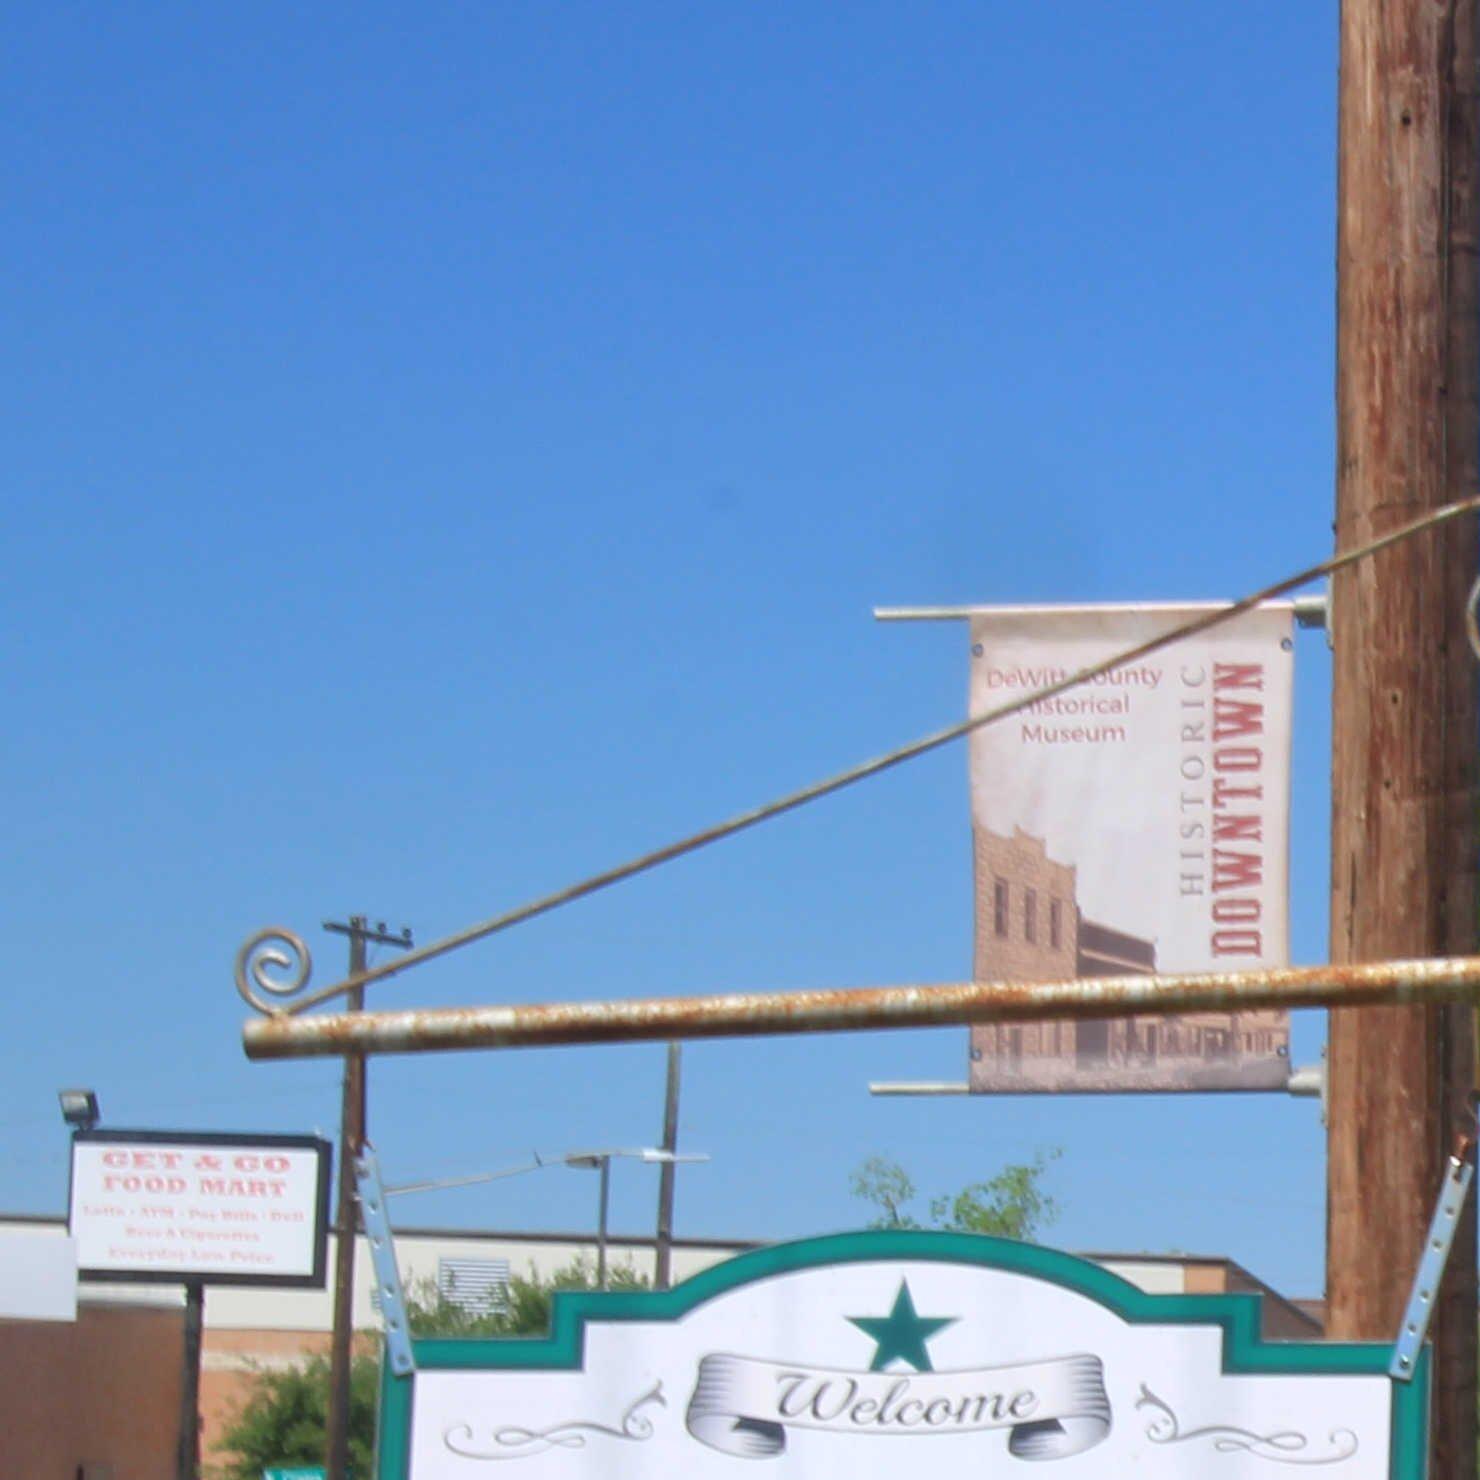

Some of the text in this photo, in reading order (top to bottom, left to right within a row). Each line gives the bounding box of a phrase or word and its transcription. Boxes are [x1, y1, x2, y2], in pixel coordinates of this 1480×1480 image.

[987, 667, 1066, 690] DeWitt
[1021, 724, 1126, 743] Museum
[1179, 664, 1205, 897] HISTORIC
[1210, 661, 1264, 958] DOWNTOWN
[102, 1149, 182, 1170] GET
[193, 1152, 223, 1172] &
[103, 1174, 287, 1199] FOOD MART
[775, 1371, 1040, 1426] Welcome
